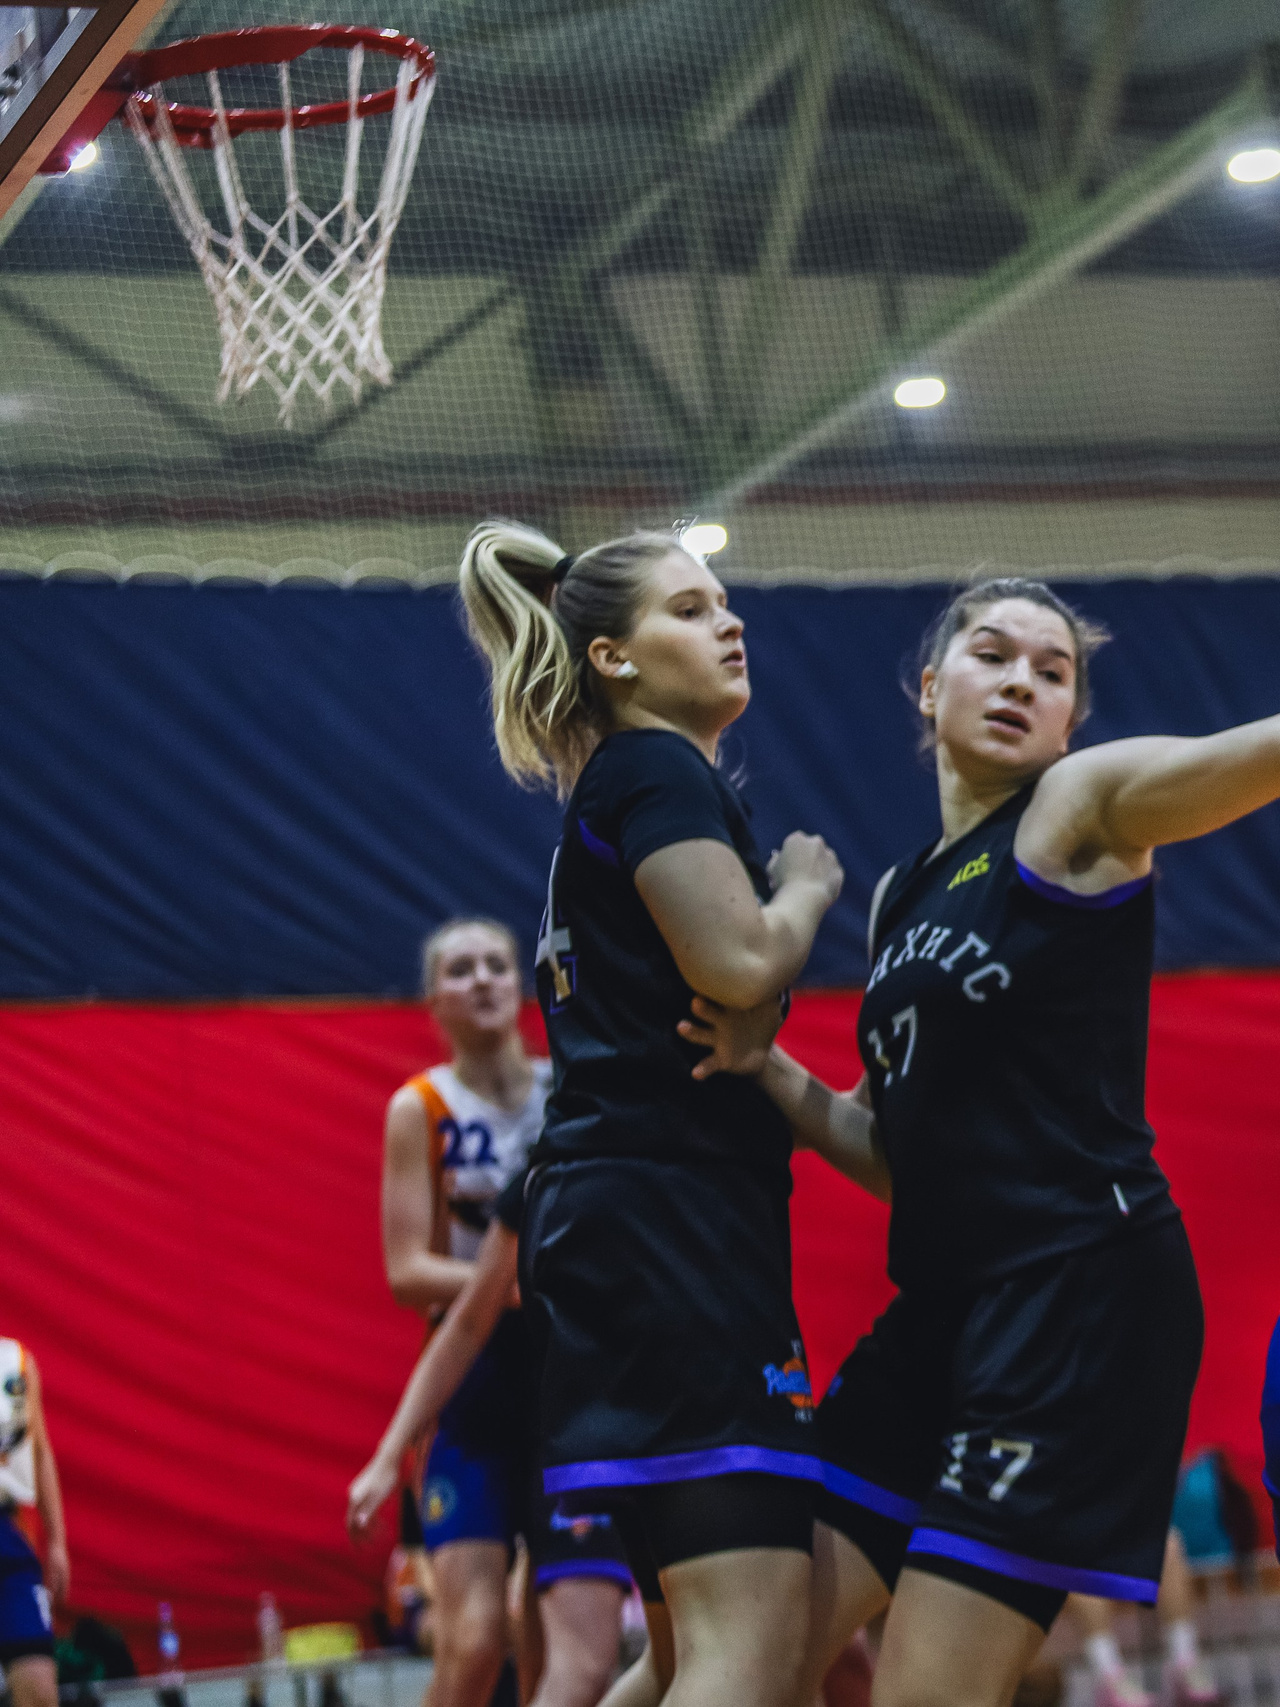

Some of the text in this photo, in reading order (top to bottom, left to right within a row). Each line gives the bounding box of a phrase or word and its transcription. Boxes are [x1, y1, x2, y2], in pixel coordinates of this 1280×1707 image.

[867, 1003, 918, 1090] 17
[437, 1116, 499, 1168] 22
[940, 1432, 1034, 1502] 17
